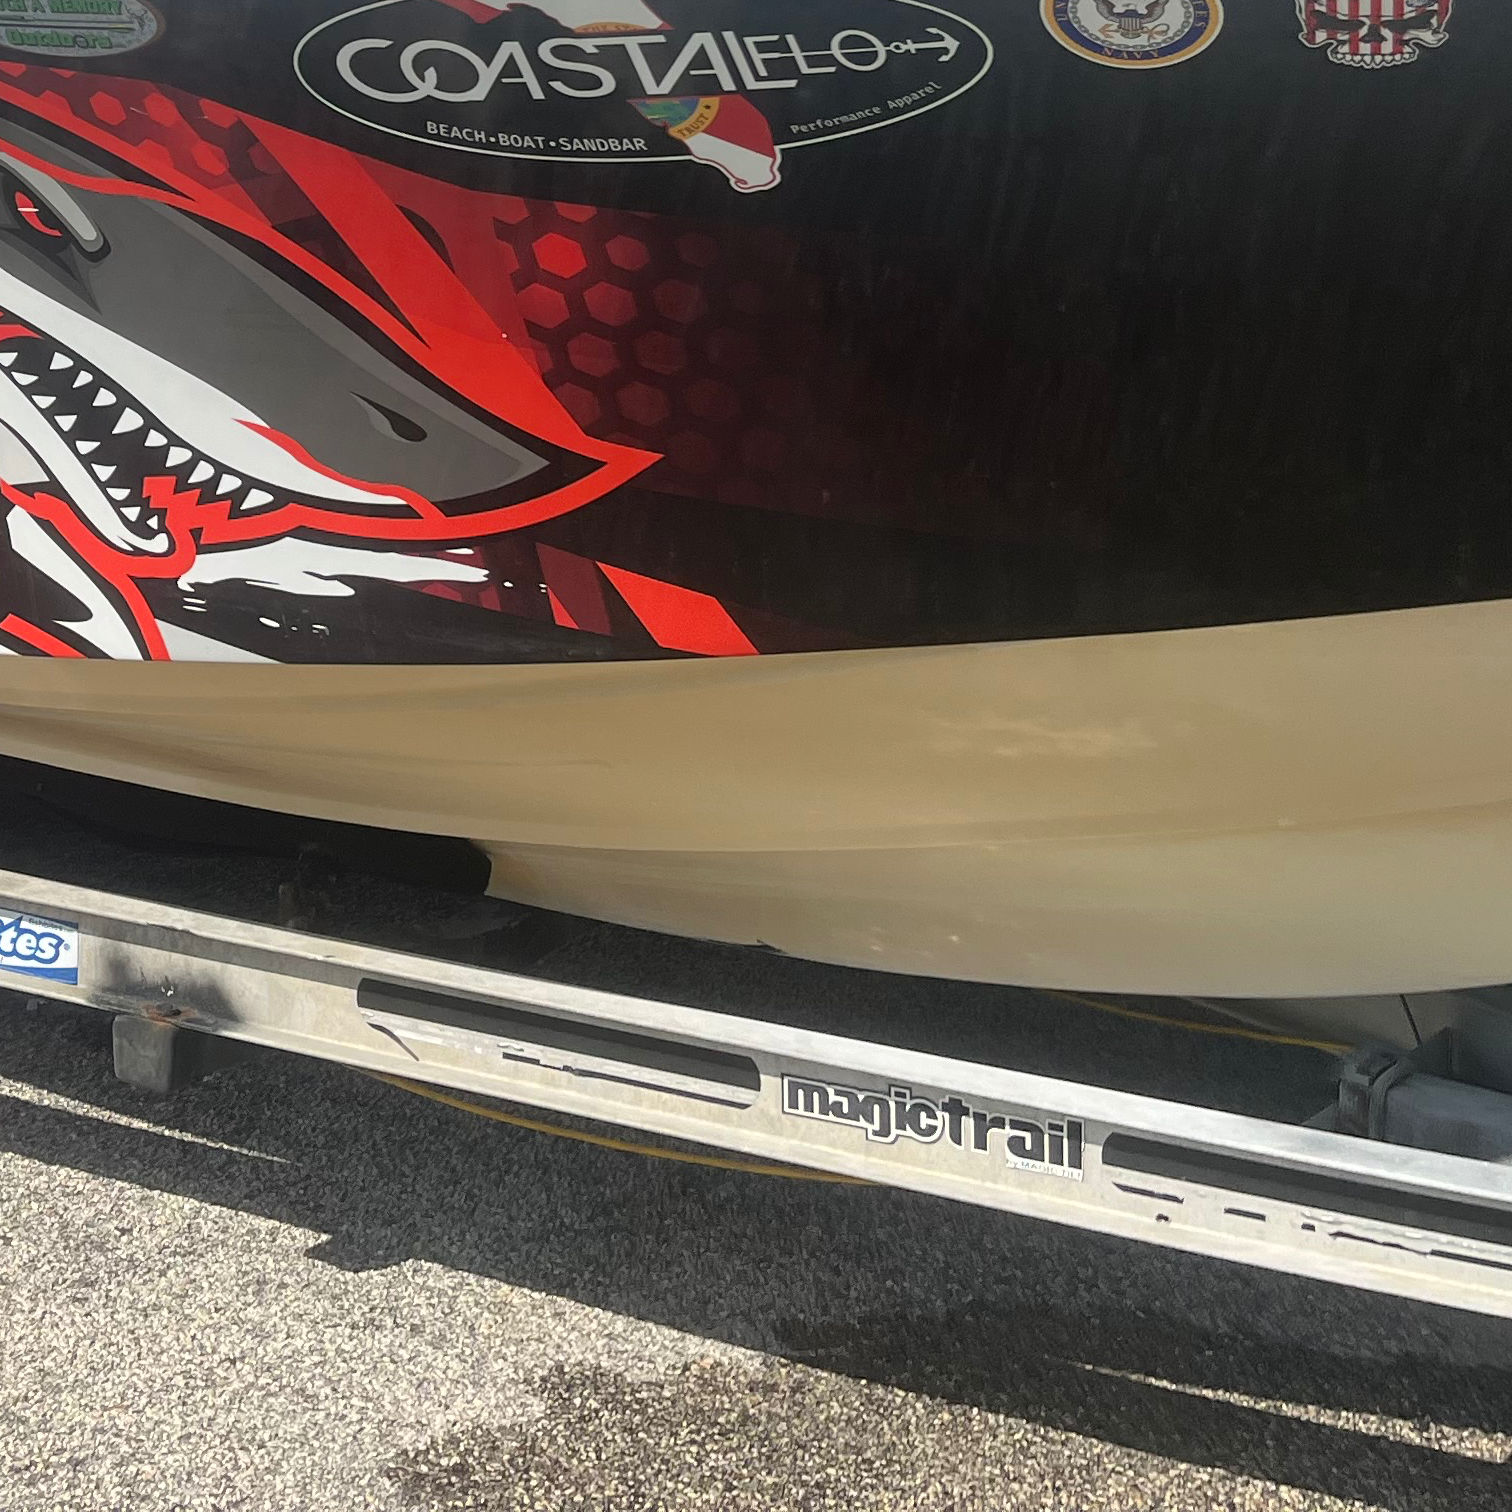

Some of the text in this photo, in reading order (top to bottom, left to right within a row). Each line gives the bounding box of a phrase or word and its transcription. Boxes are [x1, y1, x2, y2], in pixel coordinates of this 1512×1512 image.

[1101, 46, 1161, 61] NAVY
[677, 112, 710, 140] TRUST
[789, 80, 943, 134] Performance Apparel
[786, 1079, 1084, 1171] magictrail
